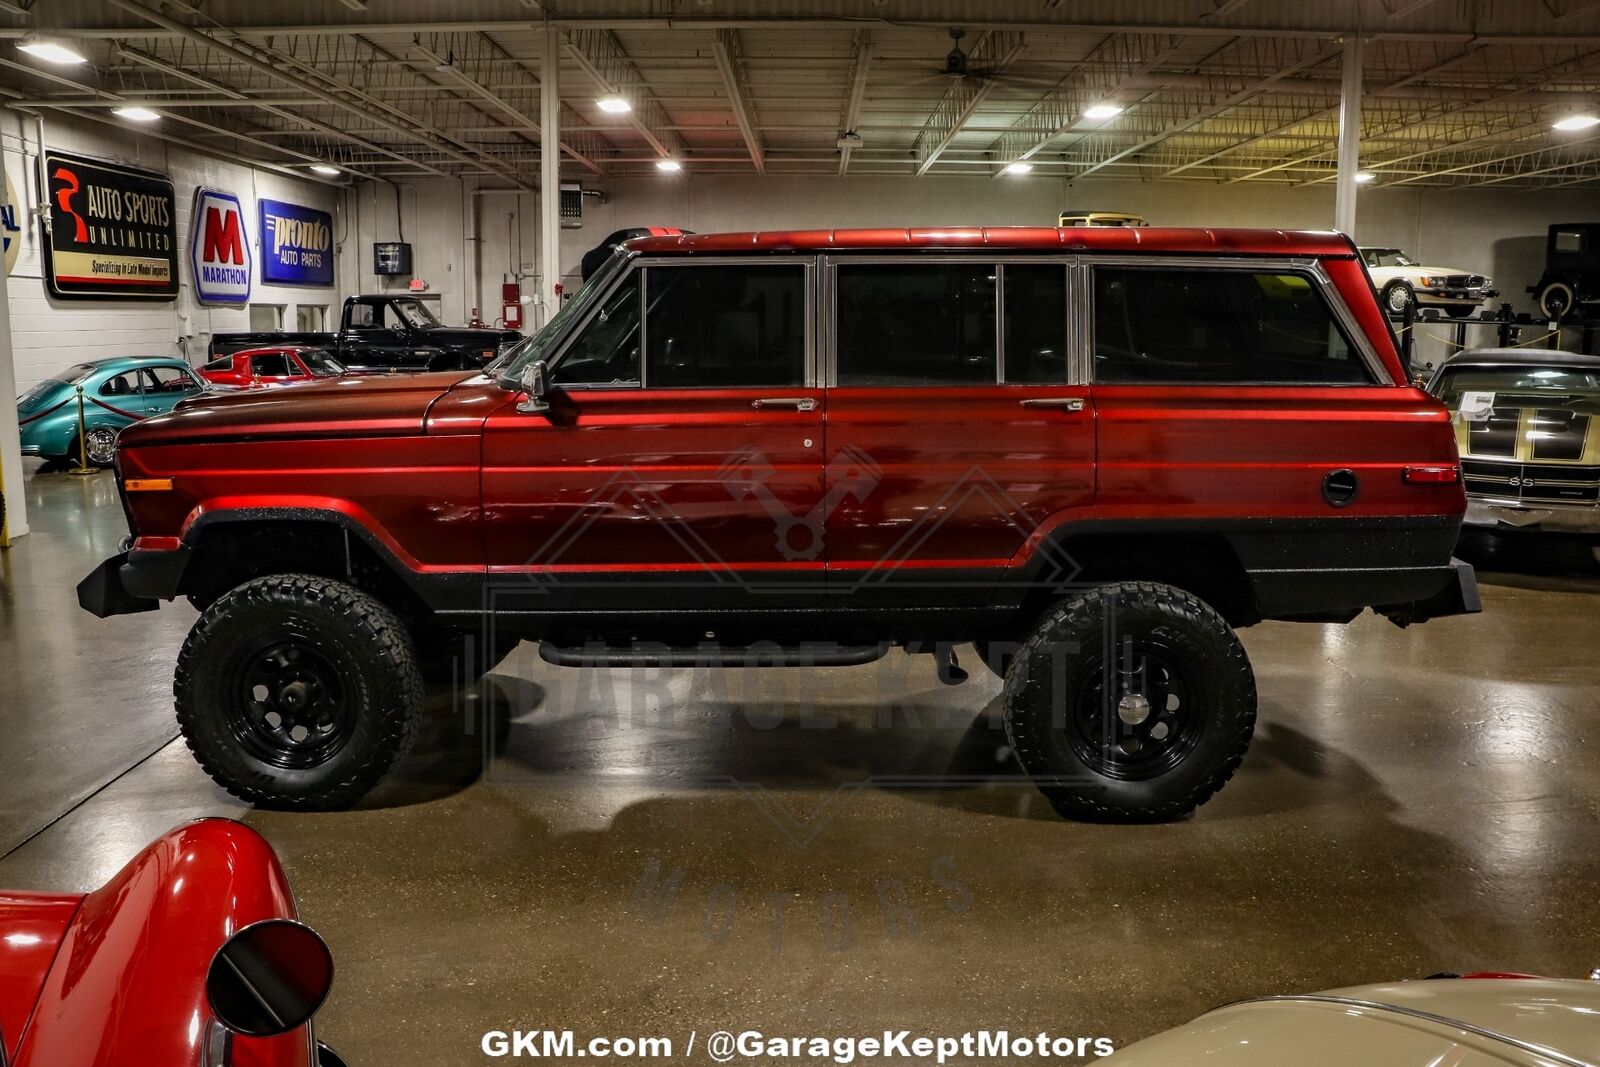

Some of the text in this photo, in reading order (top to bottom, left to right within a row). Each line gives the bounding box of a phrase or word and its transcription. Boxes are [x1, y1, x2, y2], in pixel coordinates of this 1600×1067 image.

[88, 185, 169, 227] AUTO SPORTS
[89, 226, 169, 251] UNLIMITED
[203, 206, 244, 265] M
[273, 216, 330, 255] pronto
[92, 259, 121, 277] Specializing
[138, 263, 152, 275] Model
[280, 249, 322, 268] AUTO PARTS
[202, 266, 247, 285] MARATHON
